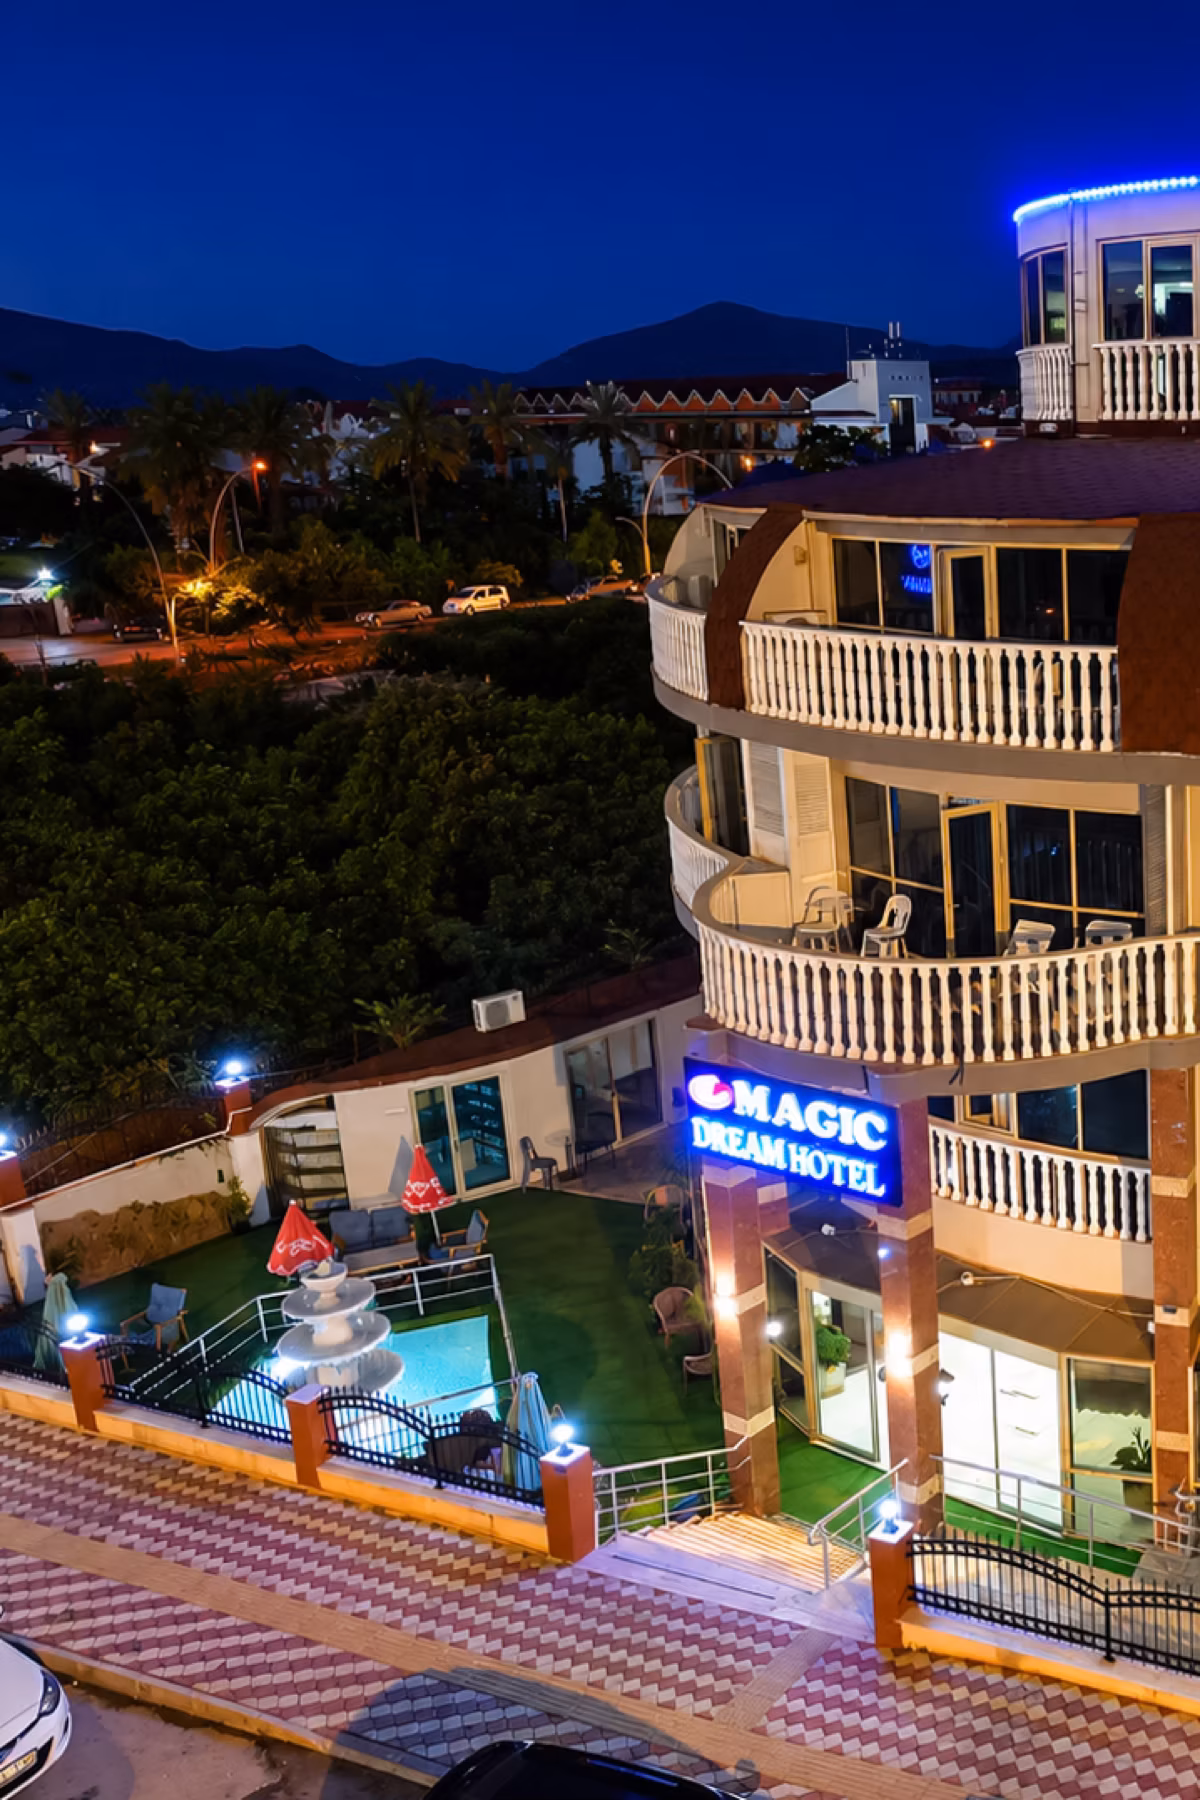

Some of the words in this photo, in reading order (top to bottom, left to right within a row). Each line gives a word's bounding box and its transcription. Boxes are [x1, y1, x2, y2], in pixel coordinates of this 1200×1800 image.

[733, 1080, 886, 1150] MAGIC
[692, 1117, 787, 1169] DREAM
[788, 1143, 884, 1196] HOTEL
